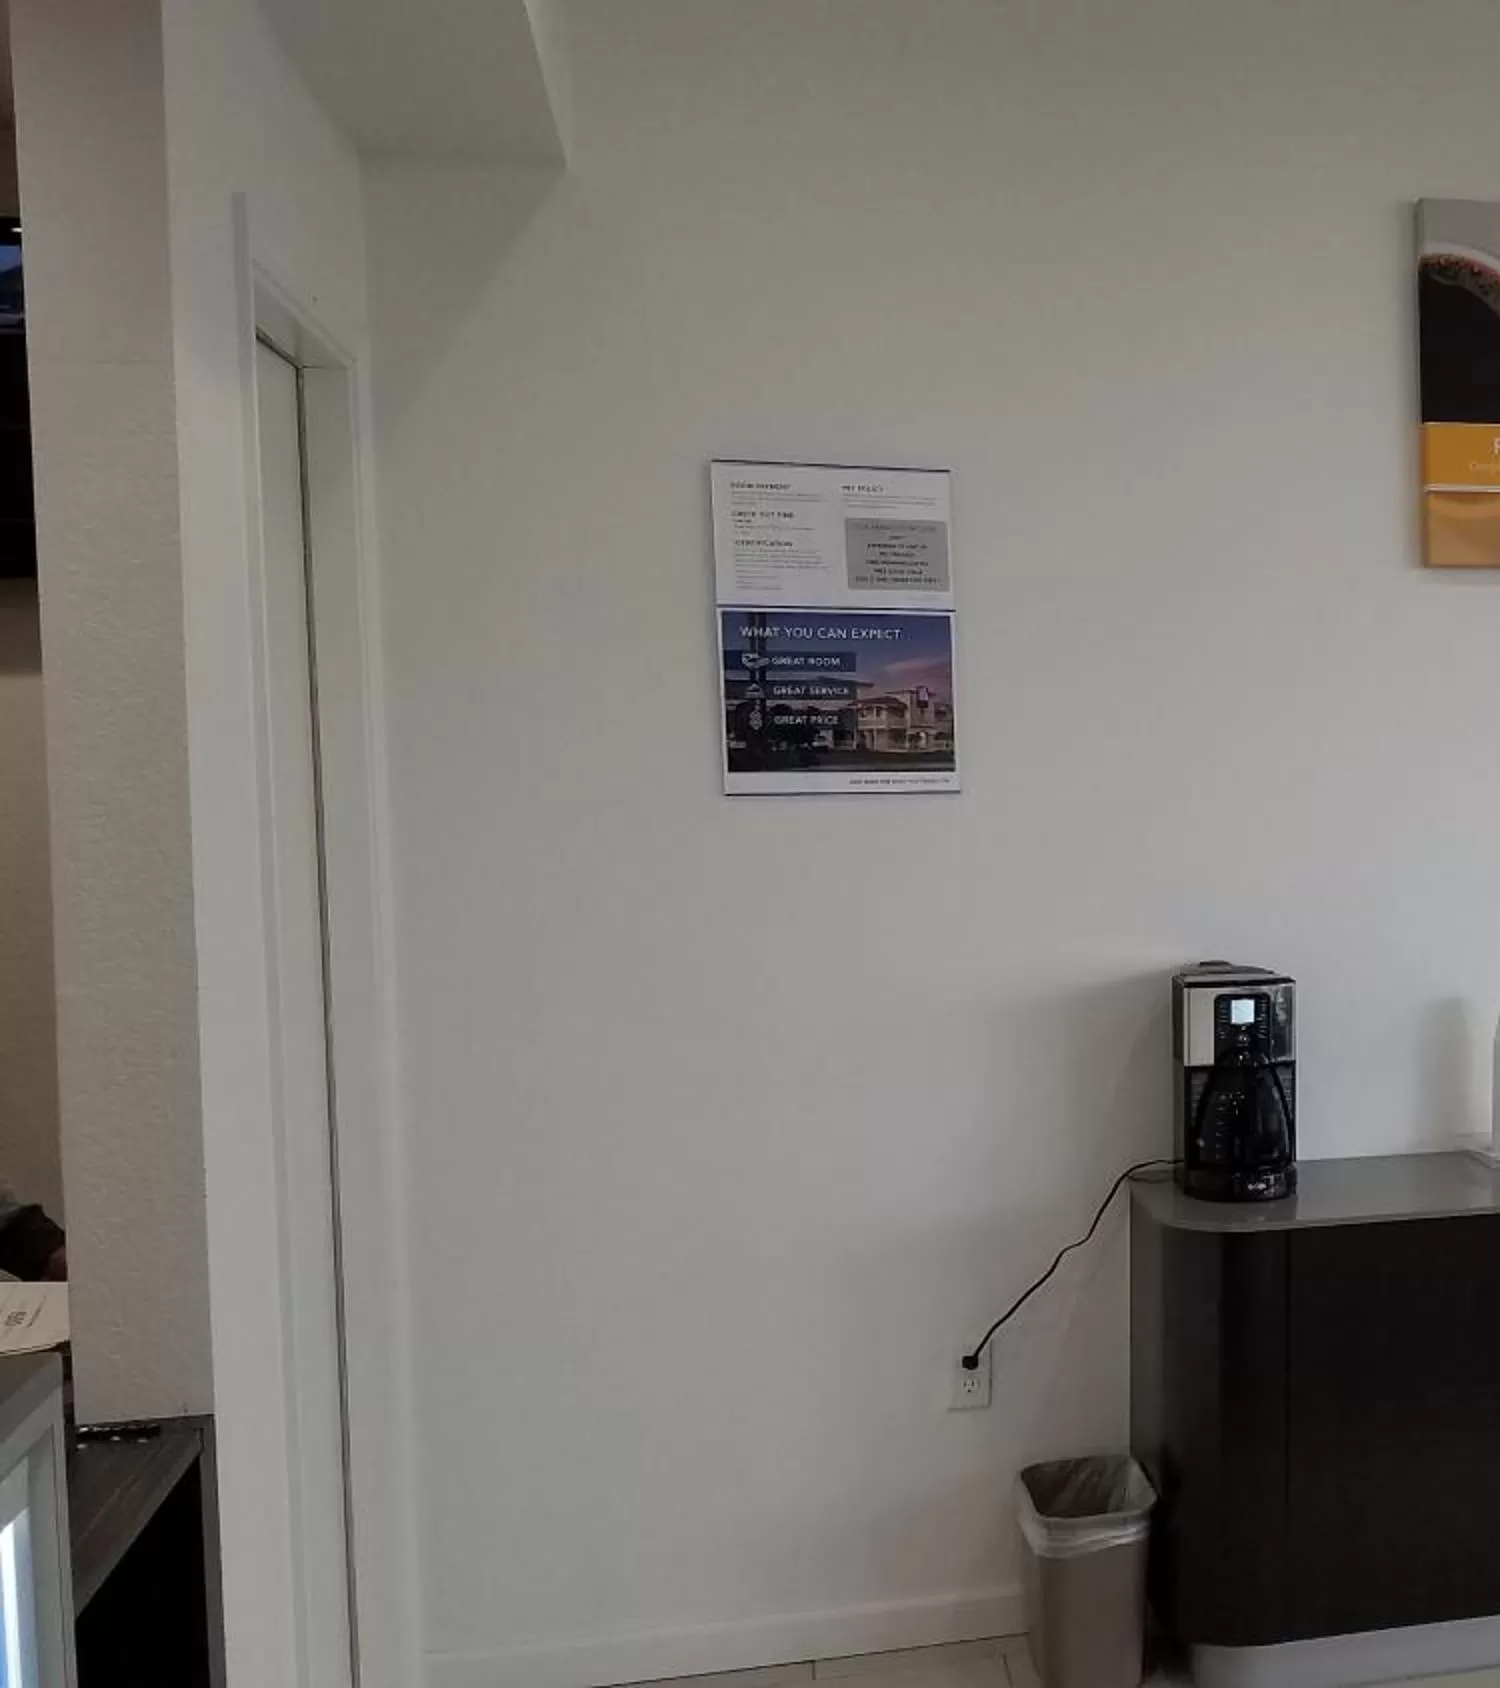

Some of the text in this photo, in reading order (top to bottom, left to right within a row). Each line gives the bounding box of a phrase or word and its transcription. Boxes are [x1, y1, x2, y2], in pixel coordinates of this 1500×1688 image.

[739, 625, 902, 641] WHAT YOU CAN EXPECT
[771, 656, 841, 667] GREAT ROOM
[773, 685, 849, 697] GREAT SERVICE
[774, 714, 839, 726] GREAT PRICE
